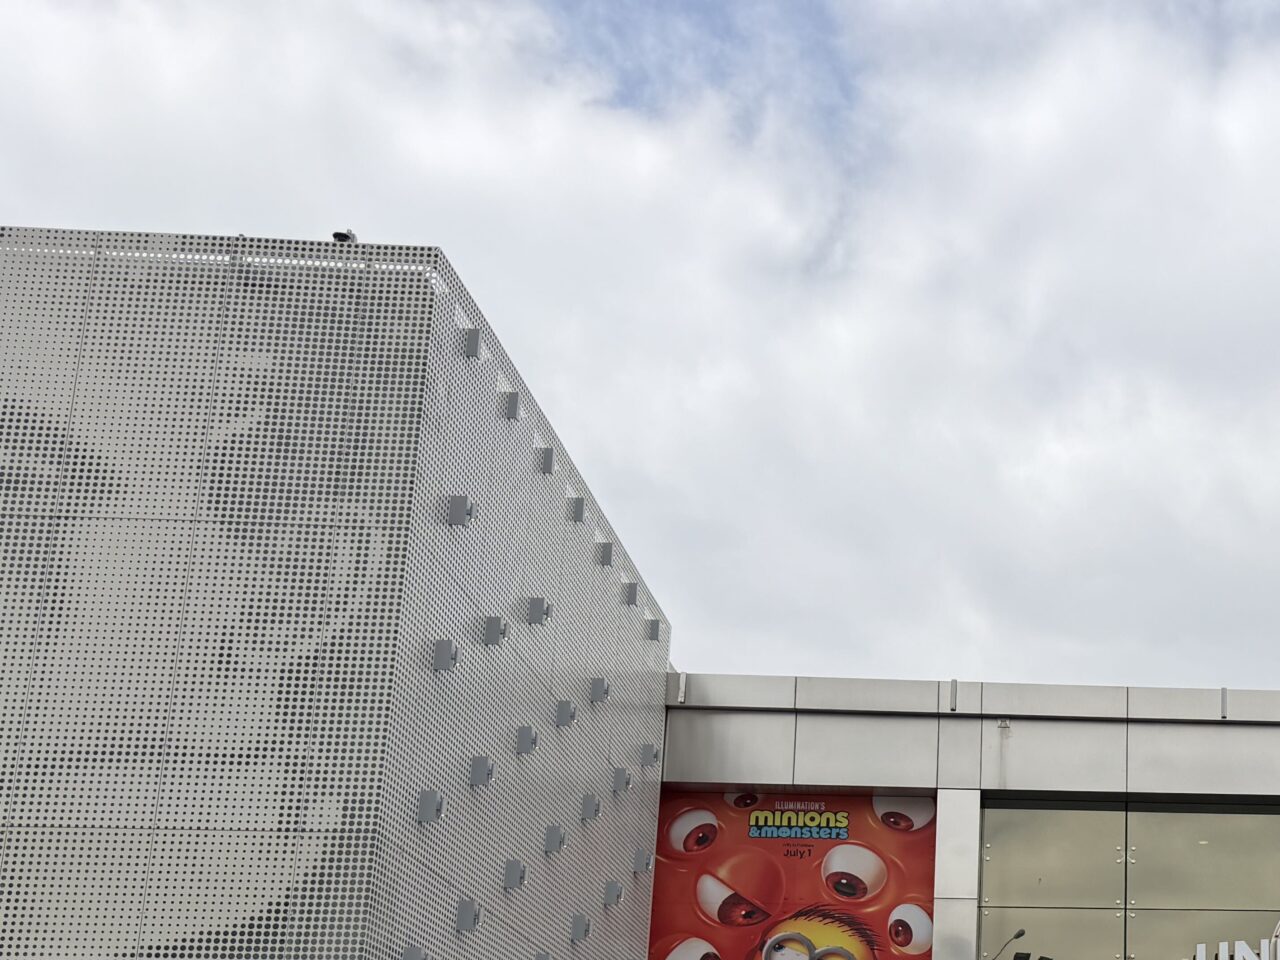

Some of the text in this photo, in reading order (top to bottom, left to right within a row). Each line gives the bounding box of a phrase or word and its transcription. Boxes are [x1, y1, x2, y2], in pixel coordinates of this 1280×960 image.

[775, 801, 825, 810] ILLUMINATION'S
[749, 810, 849, 827] minions
[783, 848, 812, 859] July 1
